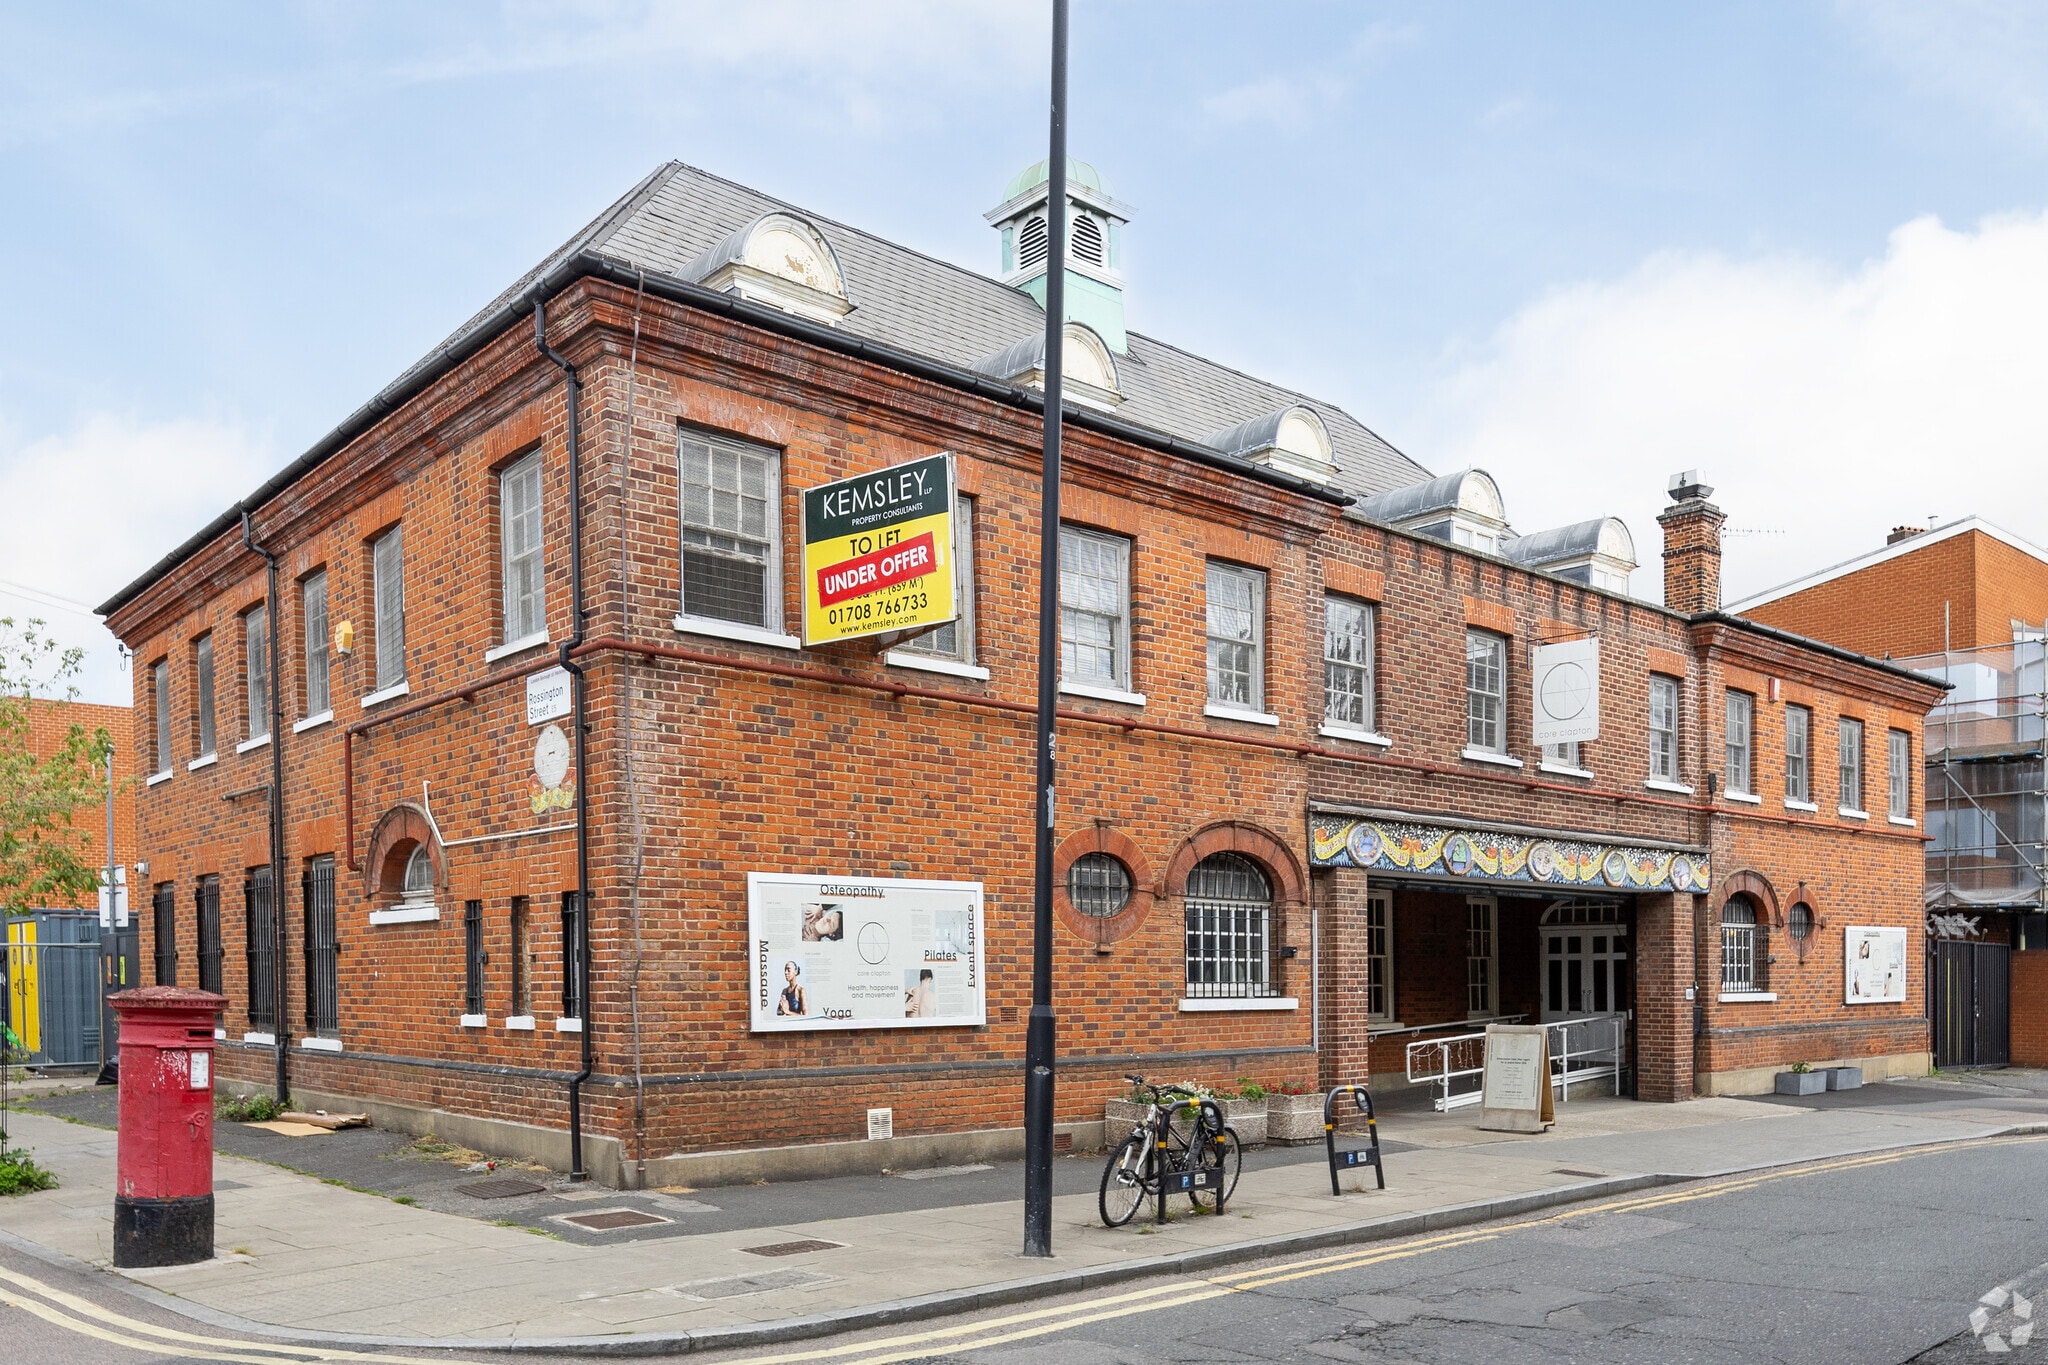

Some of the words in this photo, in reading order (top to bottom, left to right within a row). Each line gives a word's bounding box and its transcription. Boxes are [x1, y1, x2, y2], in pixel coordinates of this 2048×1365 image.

[823, 468, 928, 519] KEMSLEY
[923, 487, 933, 496] LLP
[851, 513, 882, 526] PROPERTY
[882, 502, 923, 519] CONSULTANTS
[850, 536, 872, 556] TO
[824, 562, 877, 595] UNDER
[880, 545, 929, 577] OFFER
[829, 603, 872, 625] 01708
[876, 592, 928, 617] 766733
[840, 613, 918, 634] www.kemsley.com
[528, 686, 564, 705] Rossington
[529, 703, 549, 720] Street
[1538, 730, 1558, 739] core
[1559, 726, 1592, 737] clapton
[820, 884, 884, 899] Osteopathy
[967, 904, 976, 946] space
[924, 949, 958, 961] Pilates
[759, 940, 769, 1008] Massage
[967, 951, 976, 988] Event
[864, 991, 896, 999] movement
[869, 984, 899, 992] happiness
[822, 1007, 852, 1020] Yoga
[1182, 1174, 1189, 1187] P
